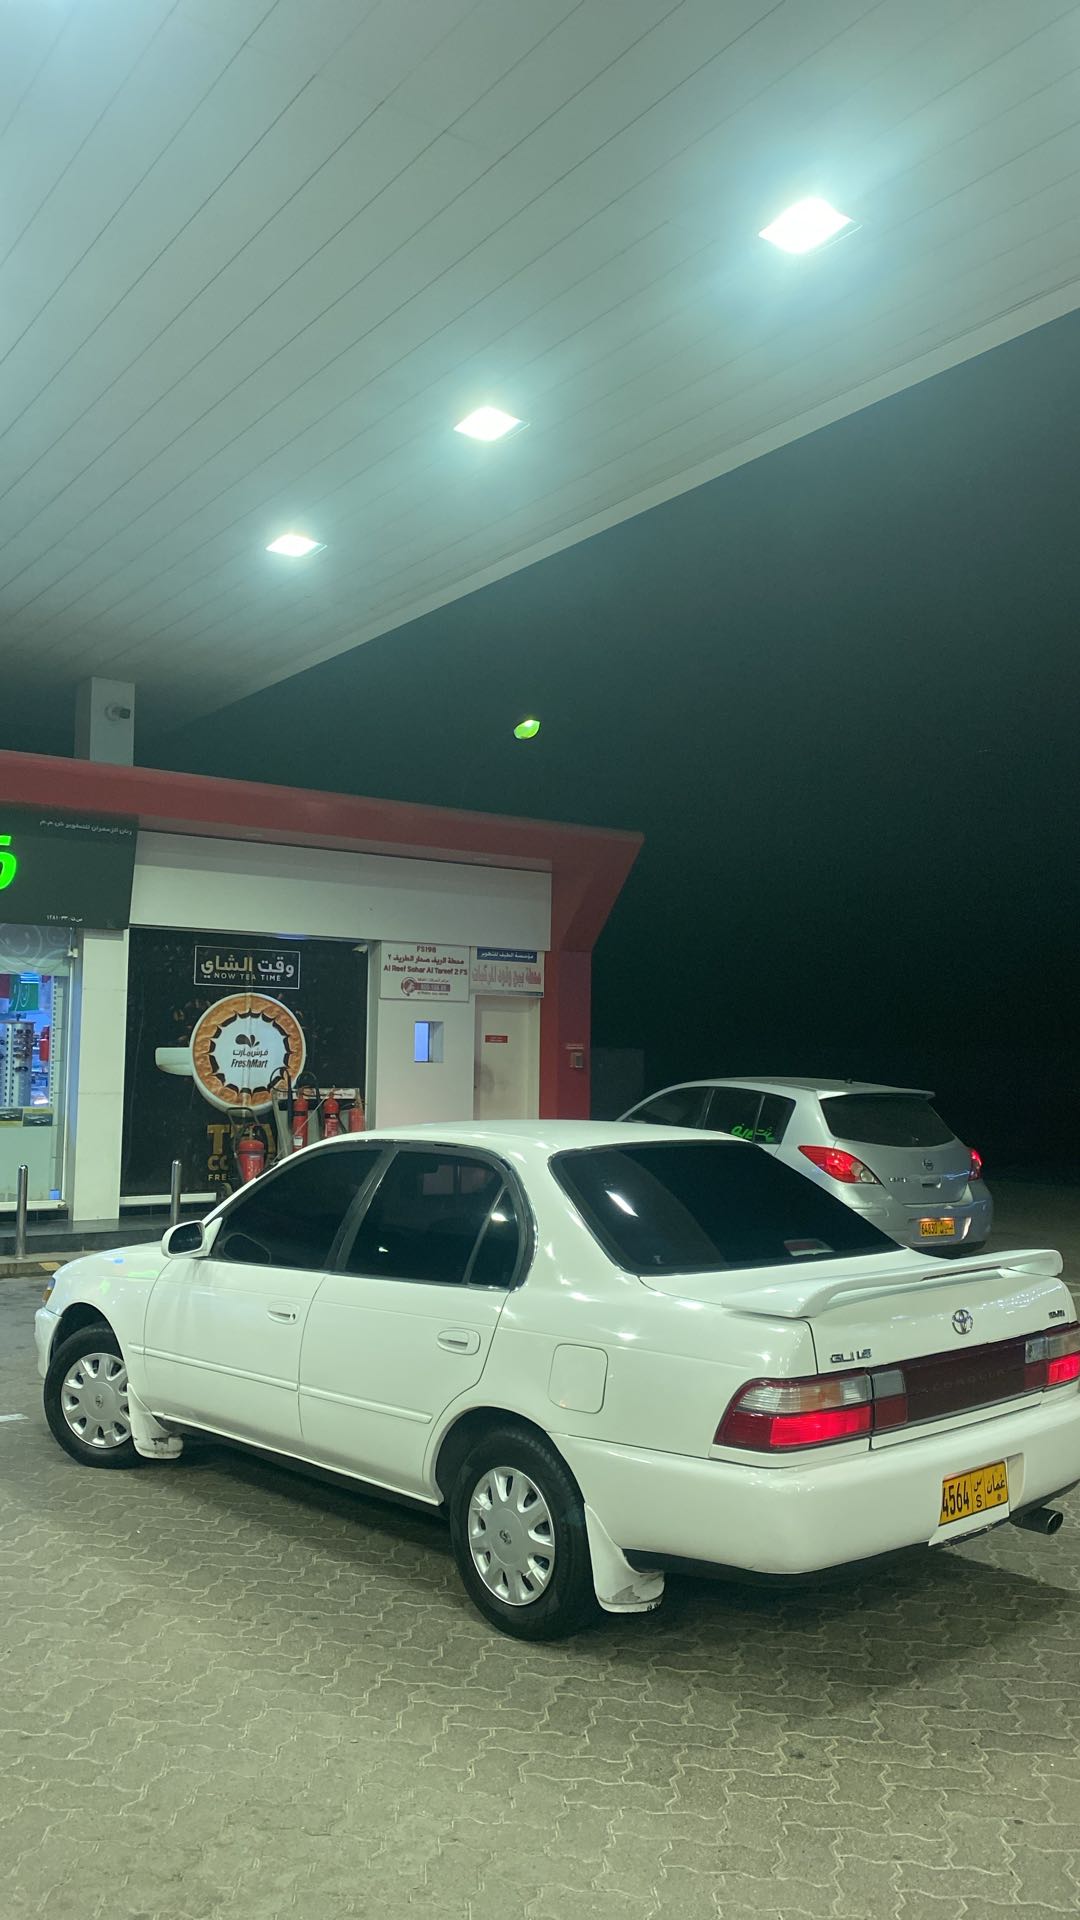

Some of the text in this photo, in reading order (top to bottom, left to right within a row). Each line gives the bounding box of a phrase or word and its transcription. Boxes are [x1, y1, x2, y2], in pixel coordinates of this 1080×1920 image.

[200, 954, 295, 979] وقت الشاي
[392, 964, 406, 972] Reef
[240, 973, 256, 981] TEA
[261, 974, 281, 982] TIME
[231, 1058, 268, 1069] FreshMart
[986, 1474, 1006, 1494] عمان
[942, 1481, 970, 1517] 4564
[976, 1494, 983, 1508] S
